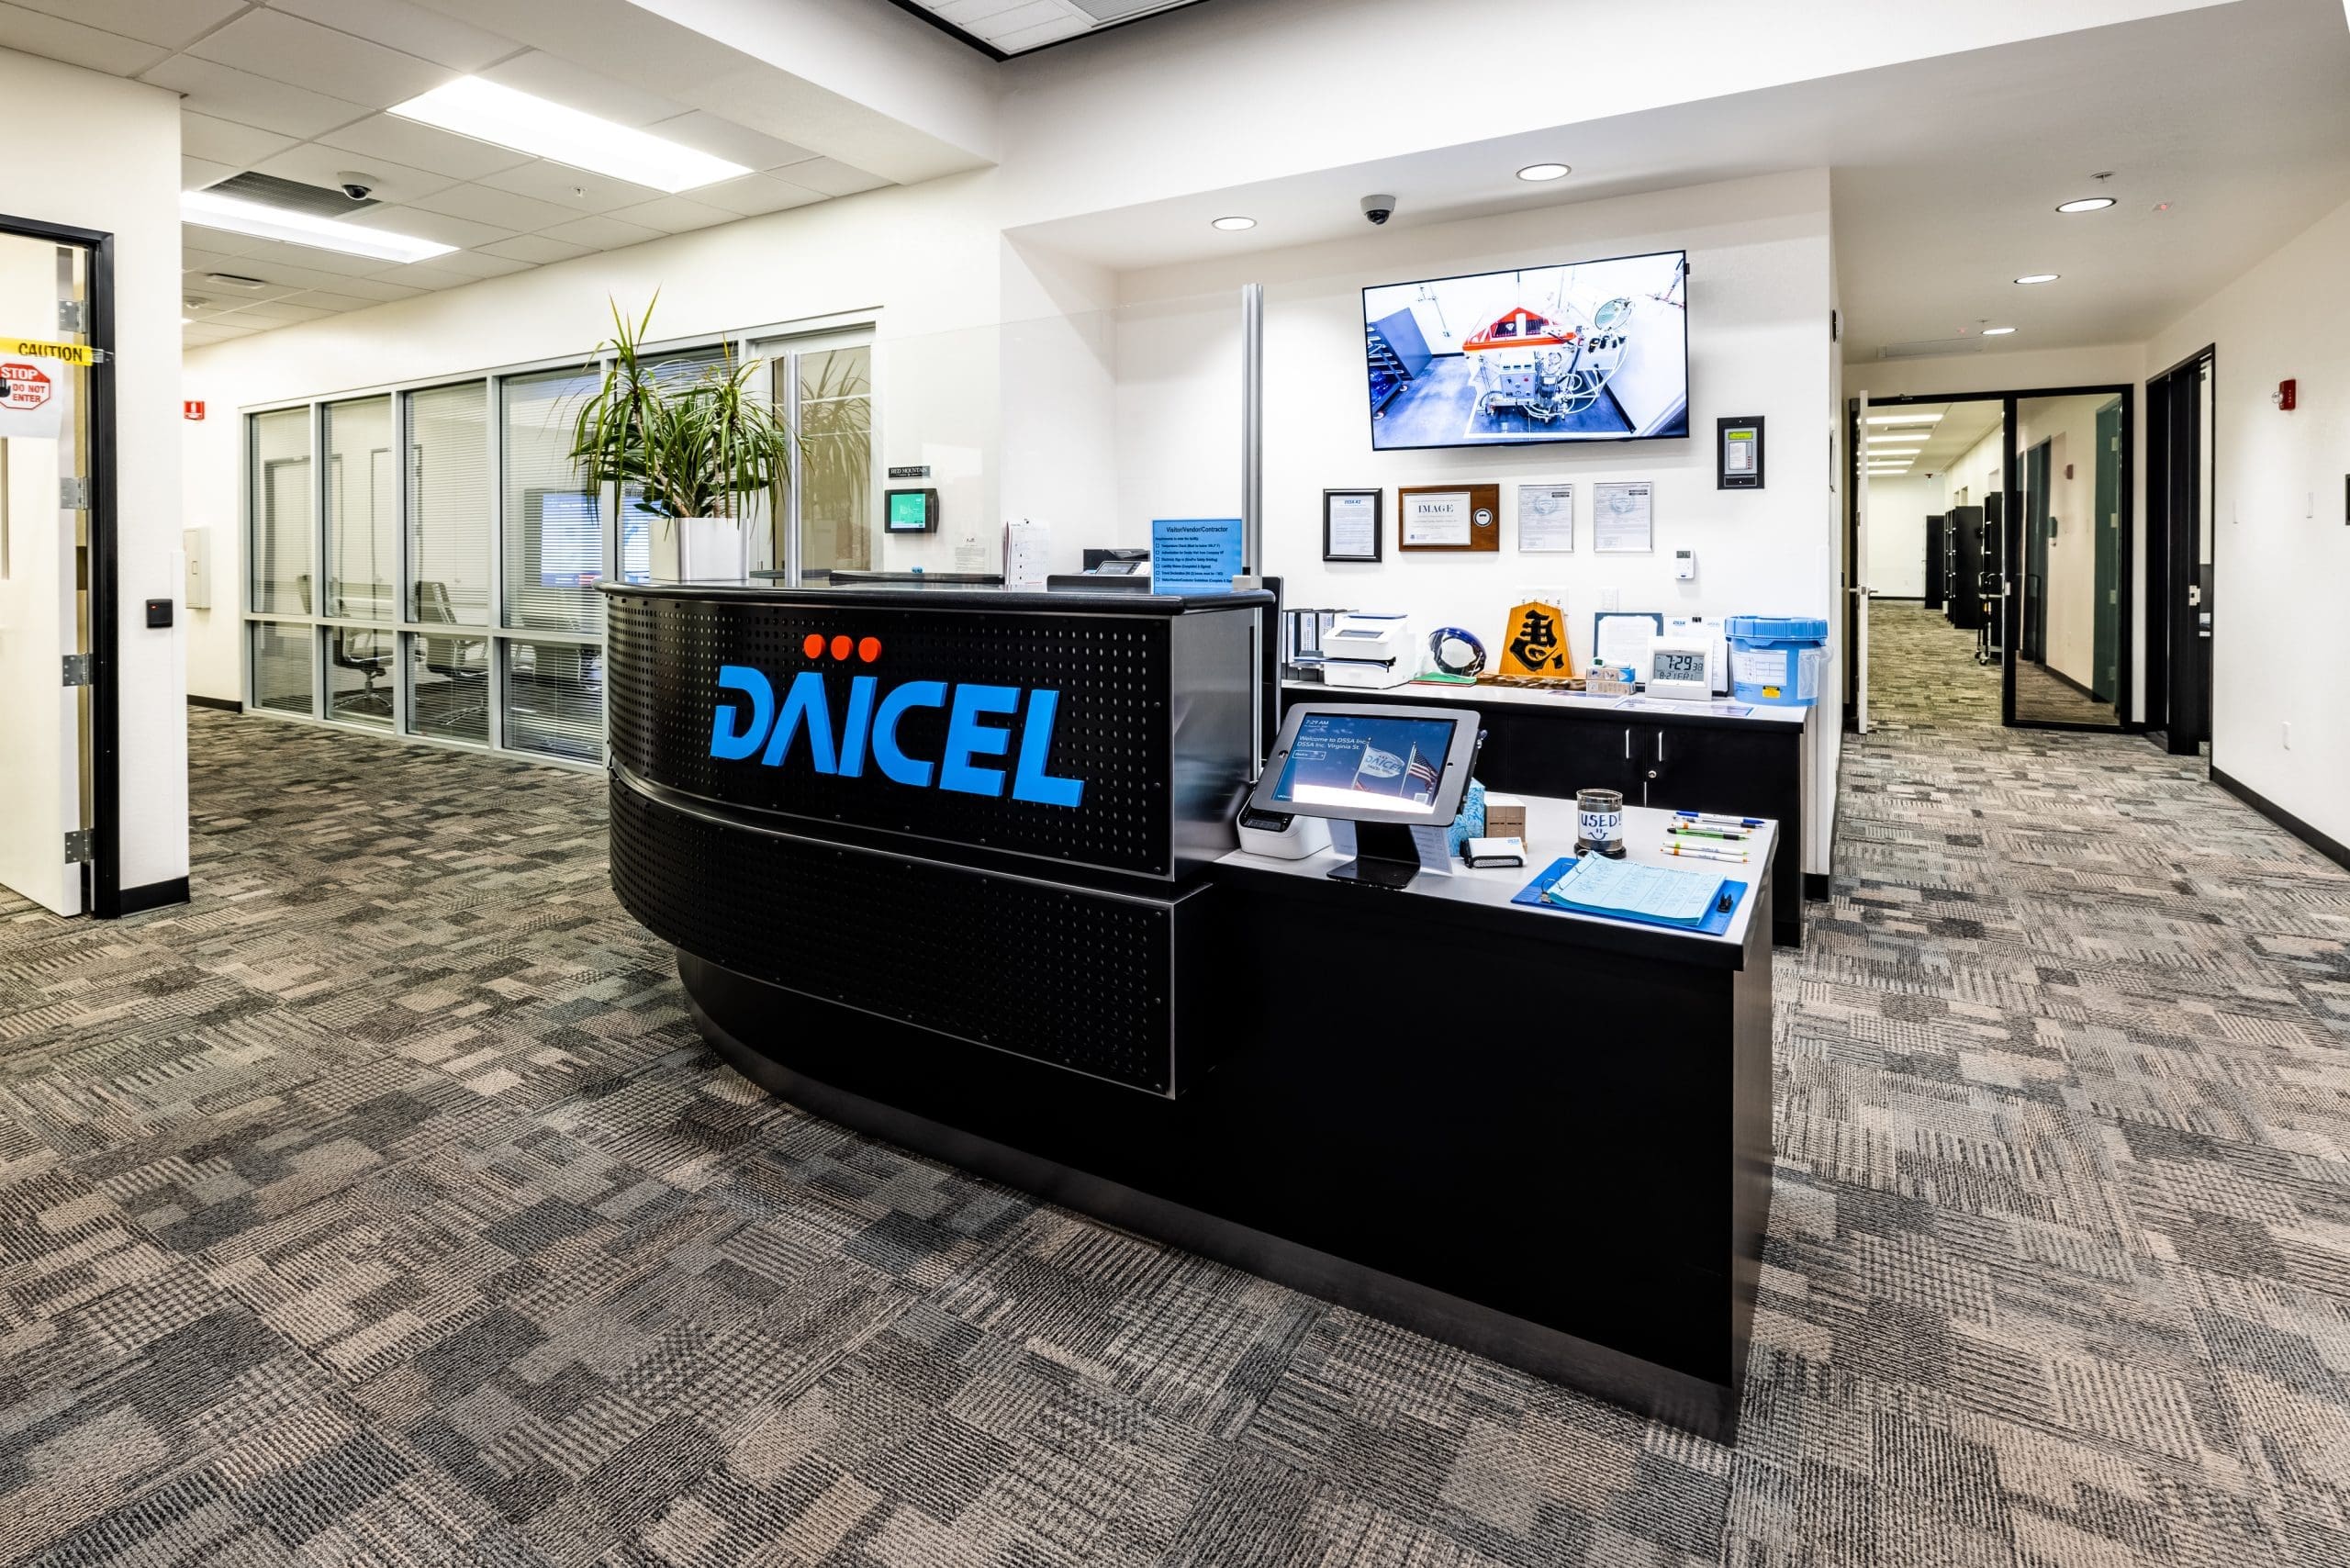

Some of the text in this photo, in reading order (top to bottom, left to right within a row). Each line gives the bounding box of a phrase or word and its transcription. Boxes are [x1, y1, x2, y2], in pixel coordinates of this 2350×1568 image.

[18, 342, 84, 363] CAUTION
[1, 367, 39, 381] STOP
[13, 384, 46, 394] DO NOT
[13, 394, 41, 403] ENTER
[1418, 504, 1454, 513] IMAGE
[1666, 655, 1704, 671] 7:29 38
[710, 666, 1085, 807] DAICEL
[1581, 813, 1622, 828] USED!
